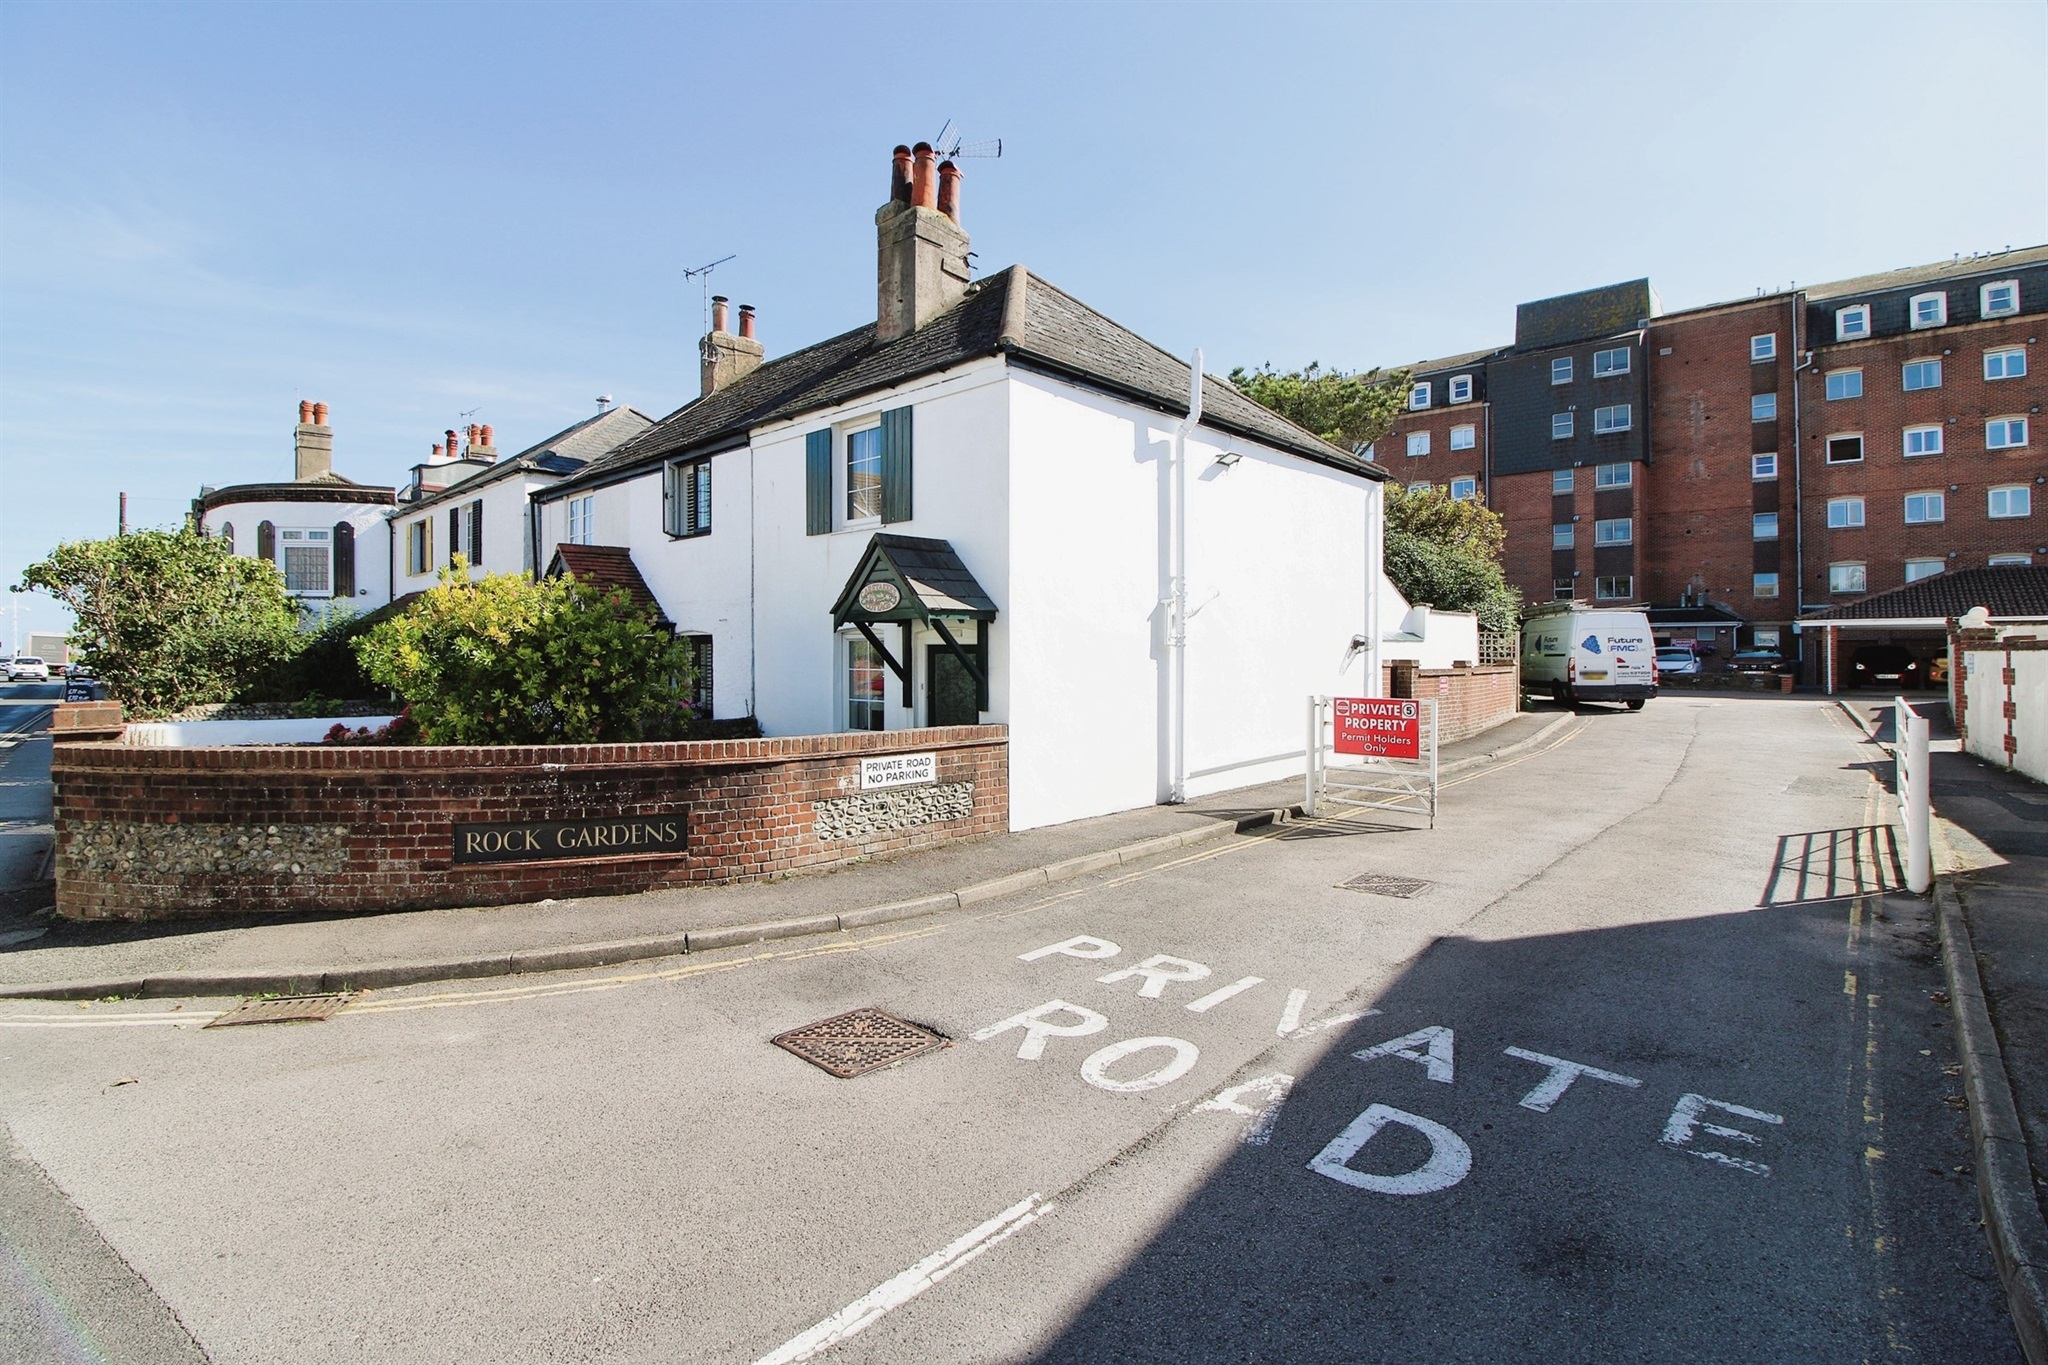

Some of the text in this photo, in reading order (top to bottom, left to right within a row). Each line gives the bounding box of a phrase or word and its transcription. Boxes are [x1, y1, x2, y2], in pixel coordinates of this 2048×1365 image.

[1351, 703, 1400, 716] PRIVATE
[1406, 706, 1412, 715] 5
[1345, 718, 1408, 732] PROPERTY
[1341, 732, 1411, 745] Permit Holders
[1364, 742, 1387, 754] Only
[866, 757, 931, 772] PRIVATE ROAD
[868, 769, 929, 784] NO PARKING
[465, 822, 678, 854] ROCK GARDENS
[1018, 934, 1785, 1178] PRIVATE
[969, 998, 1474, 1196] ROAD
